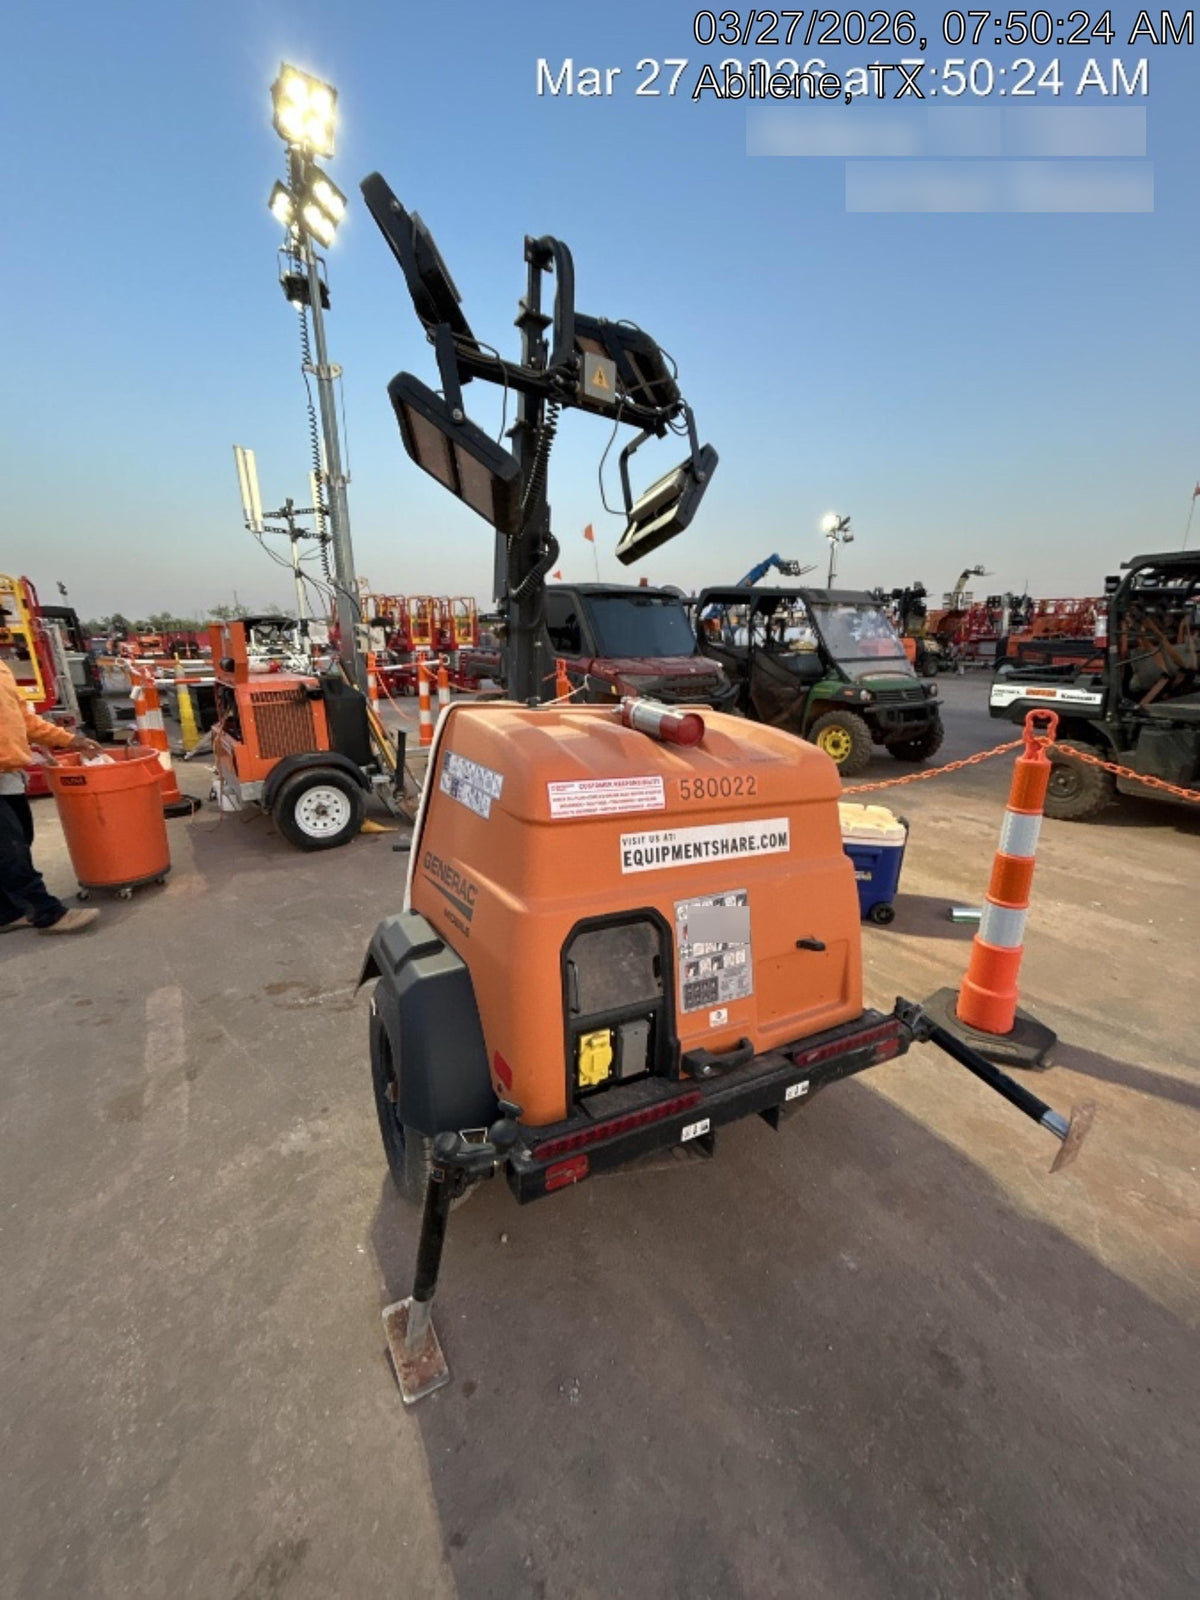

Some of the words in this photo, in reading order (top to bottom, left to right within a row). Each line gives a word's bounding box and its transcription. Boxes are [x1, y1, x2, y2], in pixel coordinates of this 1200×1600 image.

[680, 775, 757, 800] 580022
[622, 835, 646, 847] VISIT
[648, 834, 661, 844] US
[663, 832, 677, 843] AT:
[623, 831, 788, 868] EQUIPMENTSHARE.COM
[423, 851, 478, 906] GENERAC
